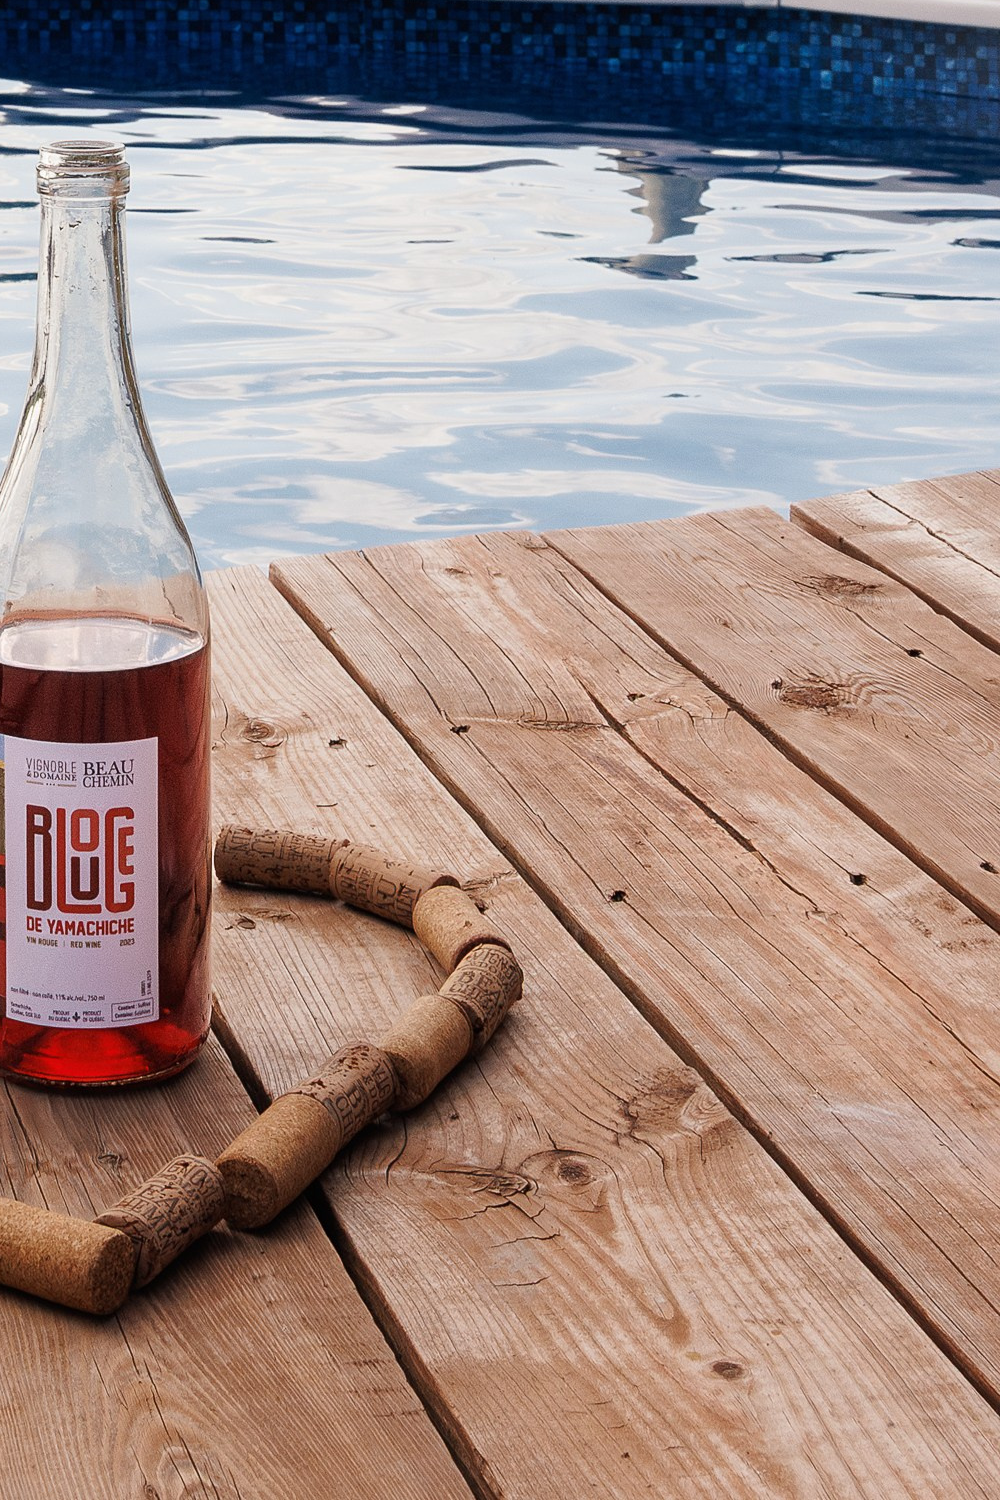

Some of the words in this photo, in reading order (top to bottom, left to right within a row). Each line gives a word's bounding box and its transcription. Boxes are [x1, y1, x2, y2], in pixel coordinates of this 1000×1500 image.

[26, 758, 77, 774] VIGNOBLE
[83, 759, 134, 776] BEAU
[33, 771, 77, 781] DOMAINE
[83, 774, 134, 788] CHEMIN
[26, 916, 43, 932] DE
[47, 918, 135, 936] YAMACHICHE
[26, 936, 37, 945] VIN
[38, 938, 58, 947] ROUGE
[85, 940, 102, 949] WINE
[119, 938, 135, 947] 2023
